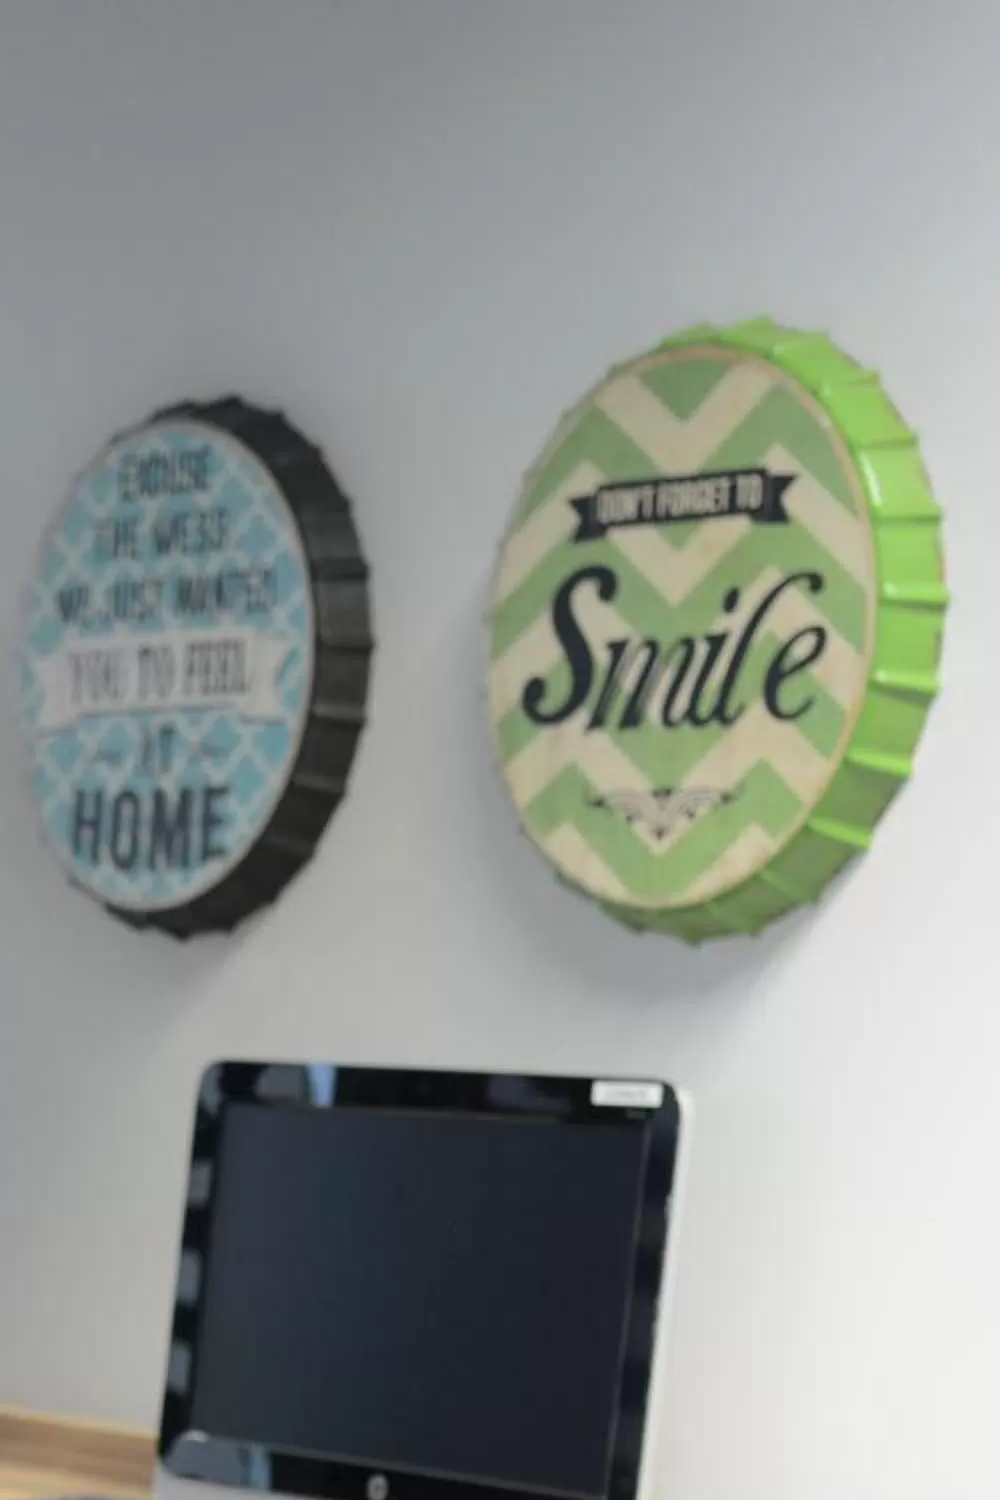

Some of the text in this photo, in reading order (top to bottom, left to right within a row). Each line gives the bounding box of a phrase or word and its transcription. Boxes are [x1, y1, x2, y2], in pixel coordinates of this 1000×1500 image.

[733, 472, 764, 511] TO
[57, 582, 96, 624] W
[522, 564, 827, 736] Smile
[72, 784, 232, 872] HOME
